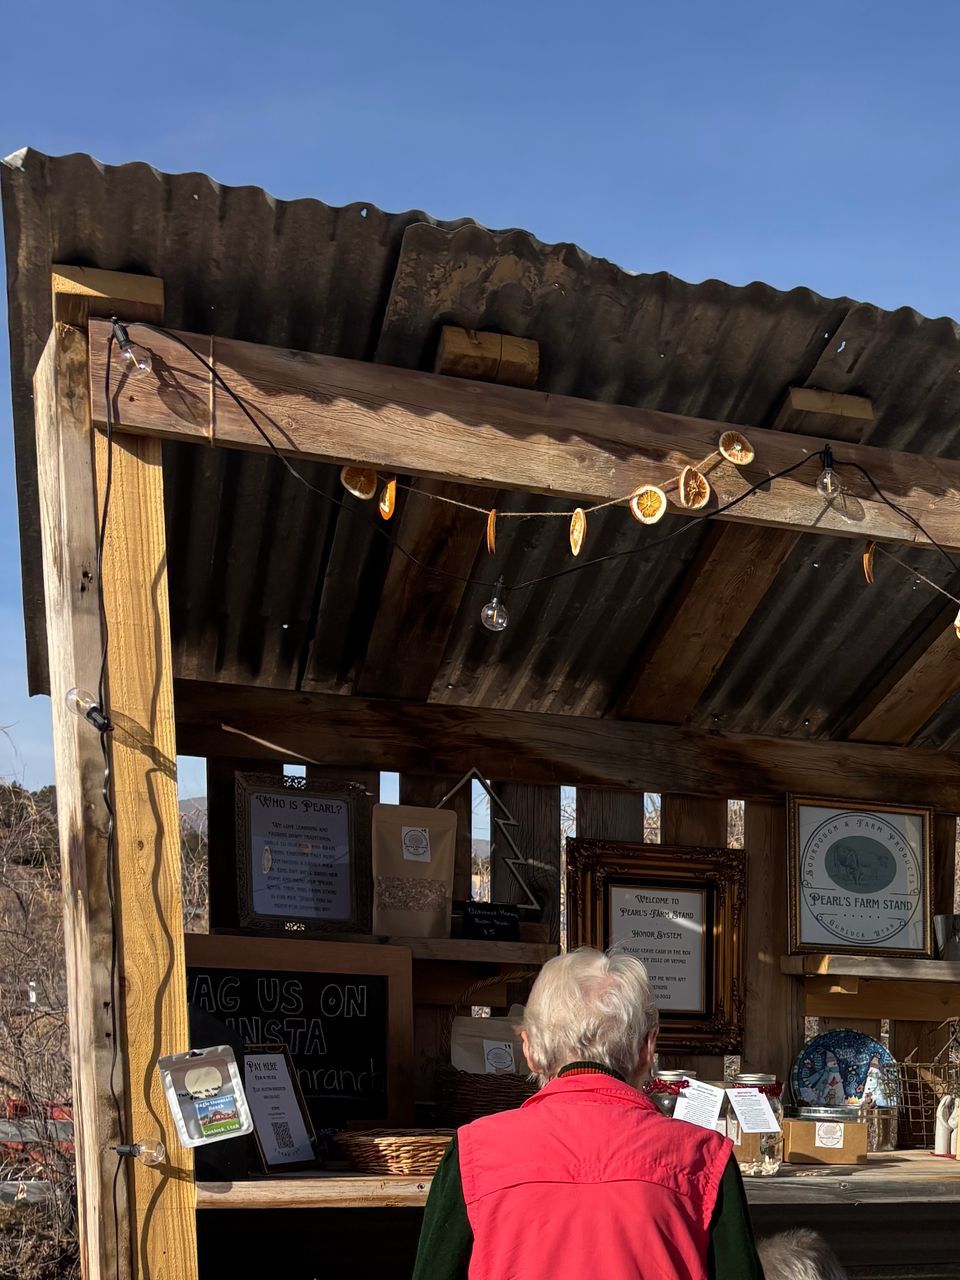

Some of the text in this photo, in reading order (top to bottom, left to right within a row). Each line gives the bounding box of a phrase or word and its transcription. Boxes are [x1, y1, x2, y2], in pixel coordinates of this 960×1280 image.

[255, 794, 343, 815] WHO IS PEARL?
[856, 818, 883, 833] FARM
[635, 894, 670, 905] WELCOME
[809, 892, 913, 911] PEARL'S FARM STAND
[620, 907, 694, 919] PEARL'S FARM STAND
[631, 930, 682, 940] HONOR SYSTEM
[192, 975, 367, 1018] AG US ON
[296, 1057, 385, 1095] nranch
